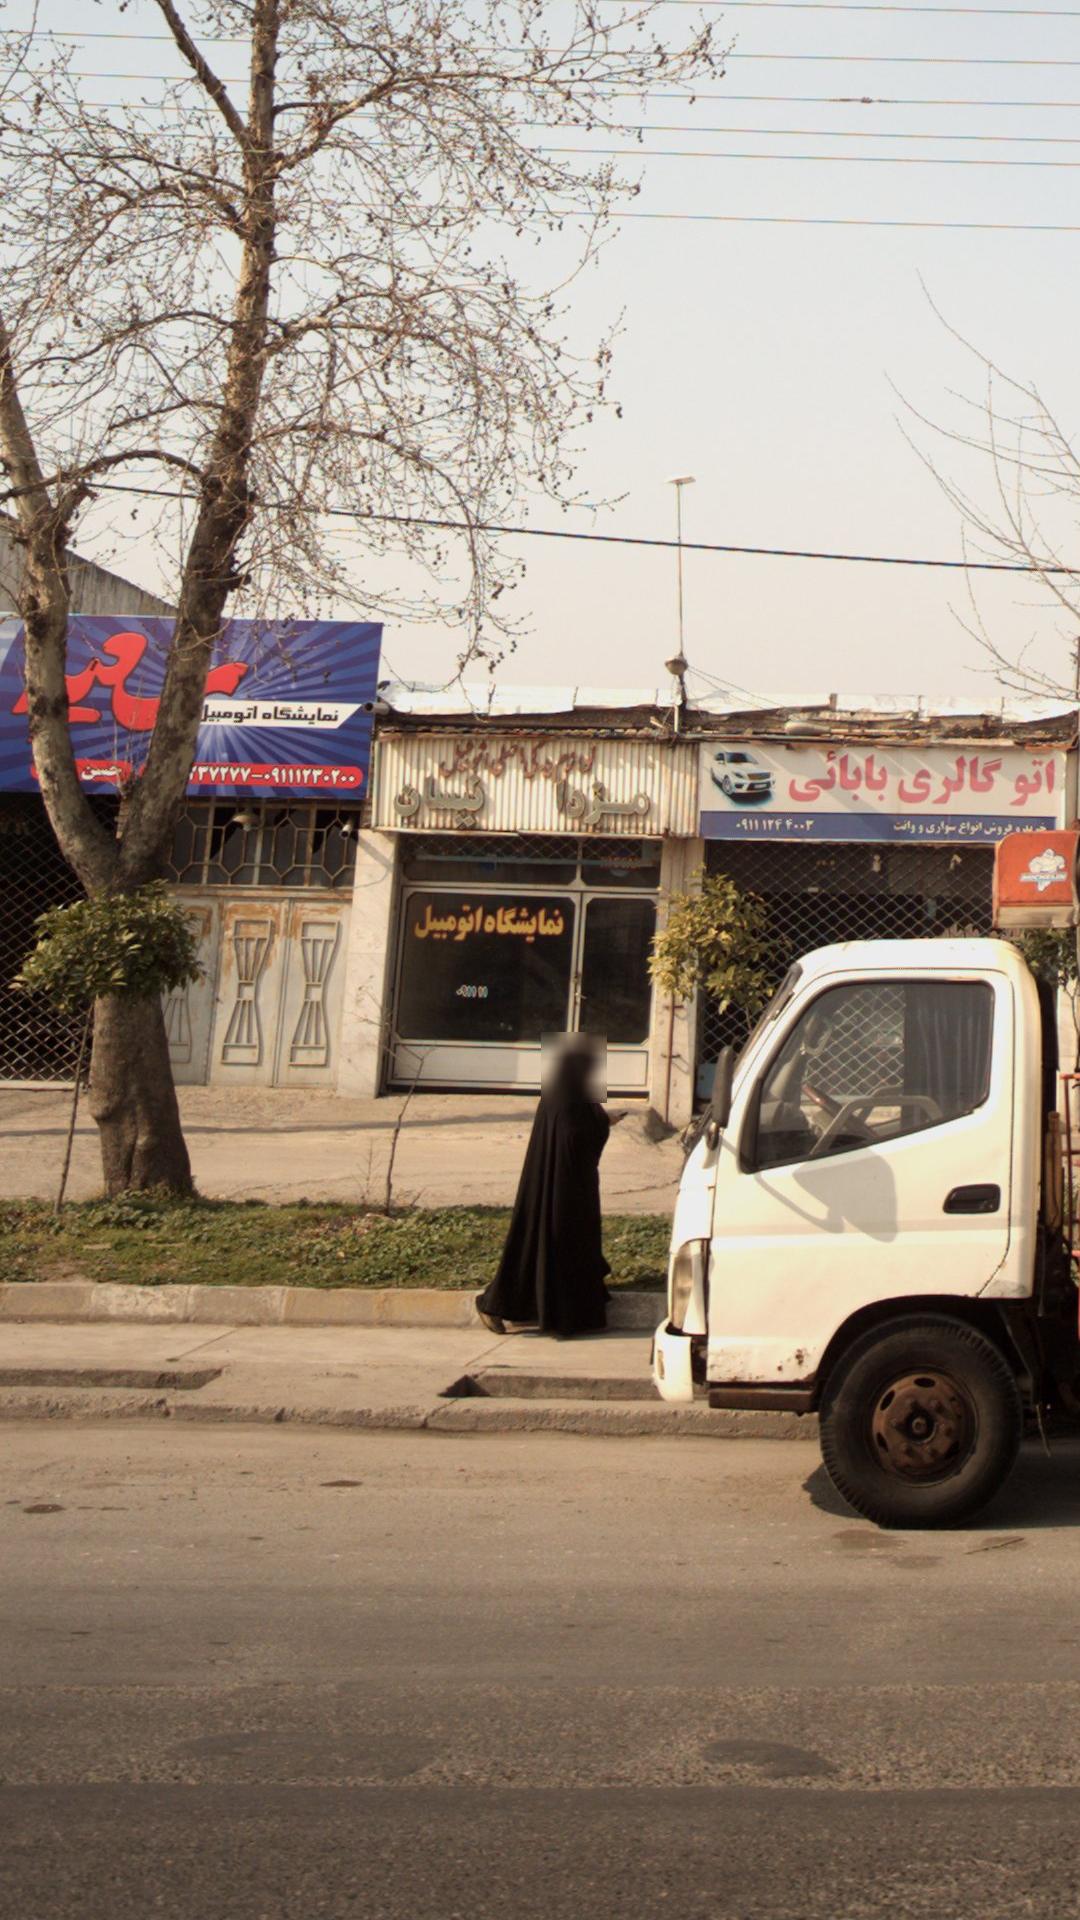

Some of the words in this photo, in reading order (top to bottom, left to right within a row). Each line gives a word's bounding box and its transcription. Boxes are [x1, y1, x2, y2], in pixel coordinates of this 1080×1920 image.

[201, 704, 258, 723] اتومبیل
[262, 705, 339, 725] نمایشگاه
[788, 750, 888, 803] بابائی
[898, 755, 1003, 805] گالری
[1010, 758, 1056, 807] اتو
[394, 774, 485, 830] نیسان
[736, 818, 759, 832] ۰۹۱۱
[926, 820, 957, 835] سواری
[958, 820, 983, 836] انواع
[414, 904, 484, 941] اتومبیل
[483, 906, 565, 944] نمایشگاه
